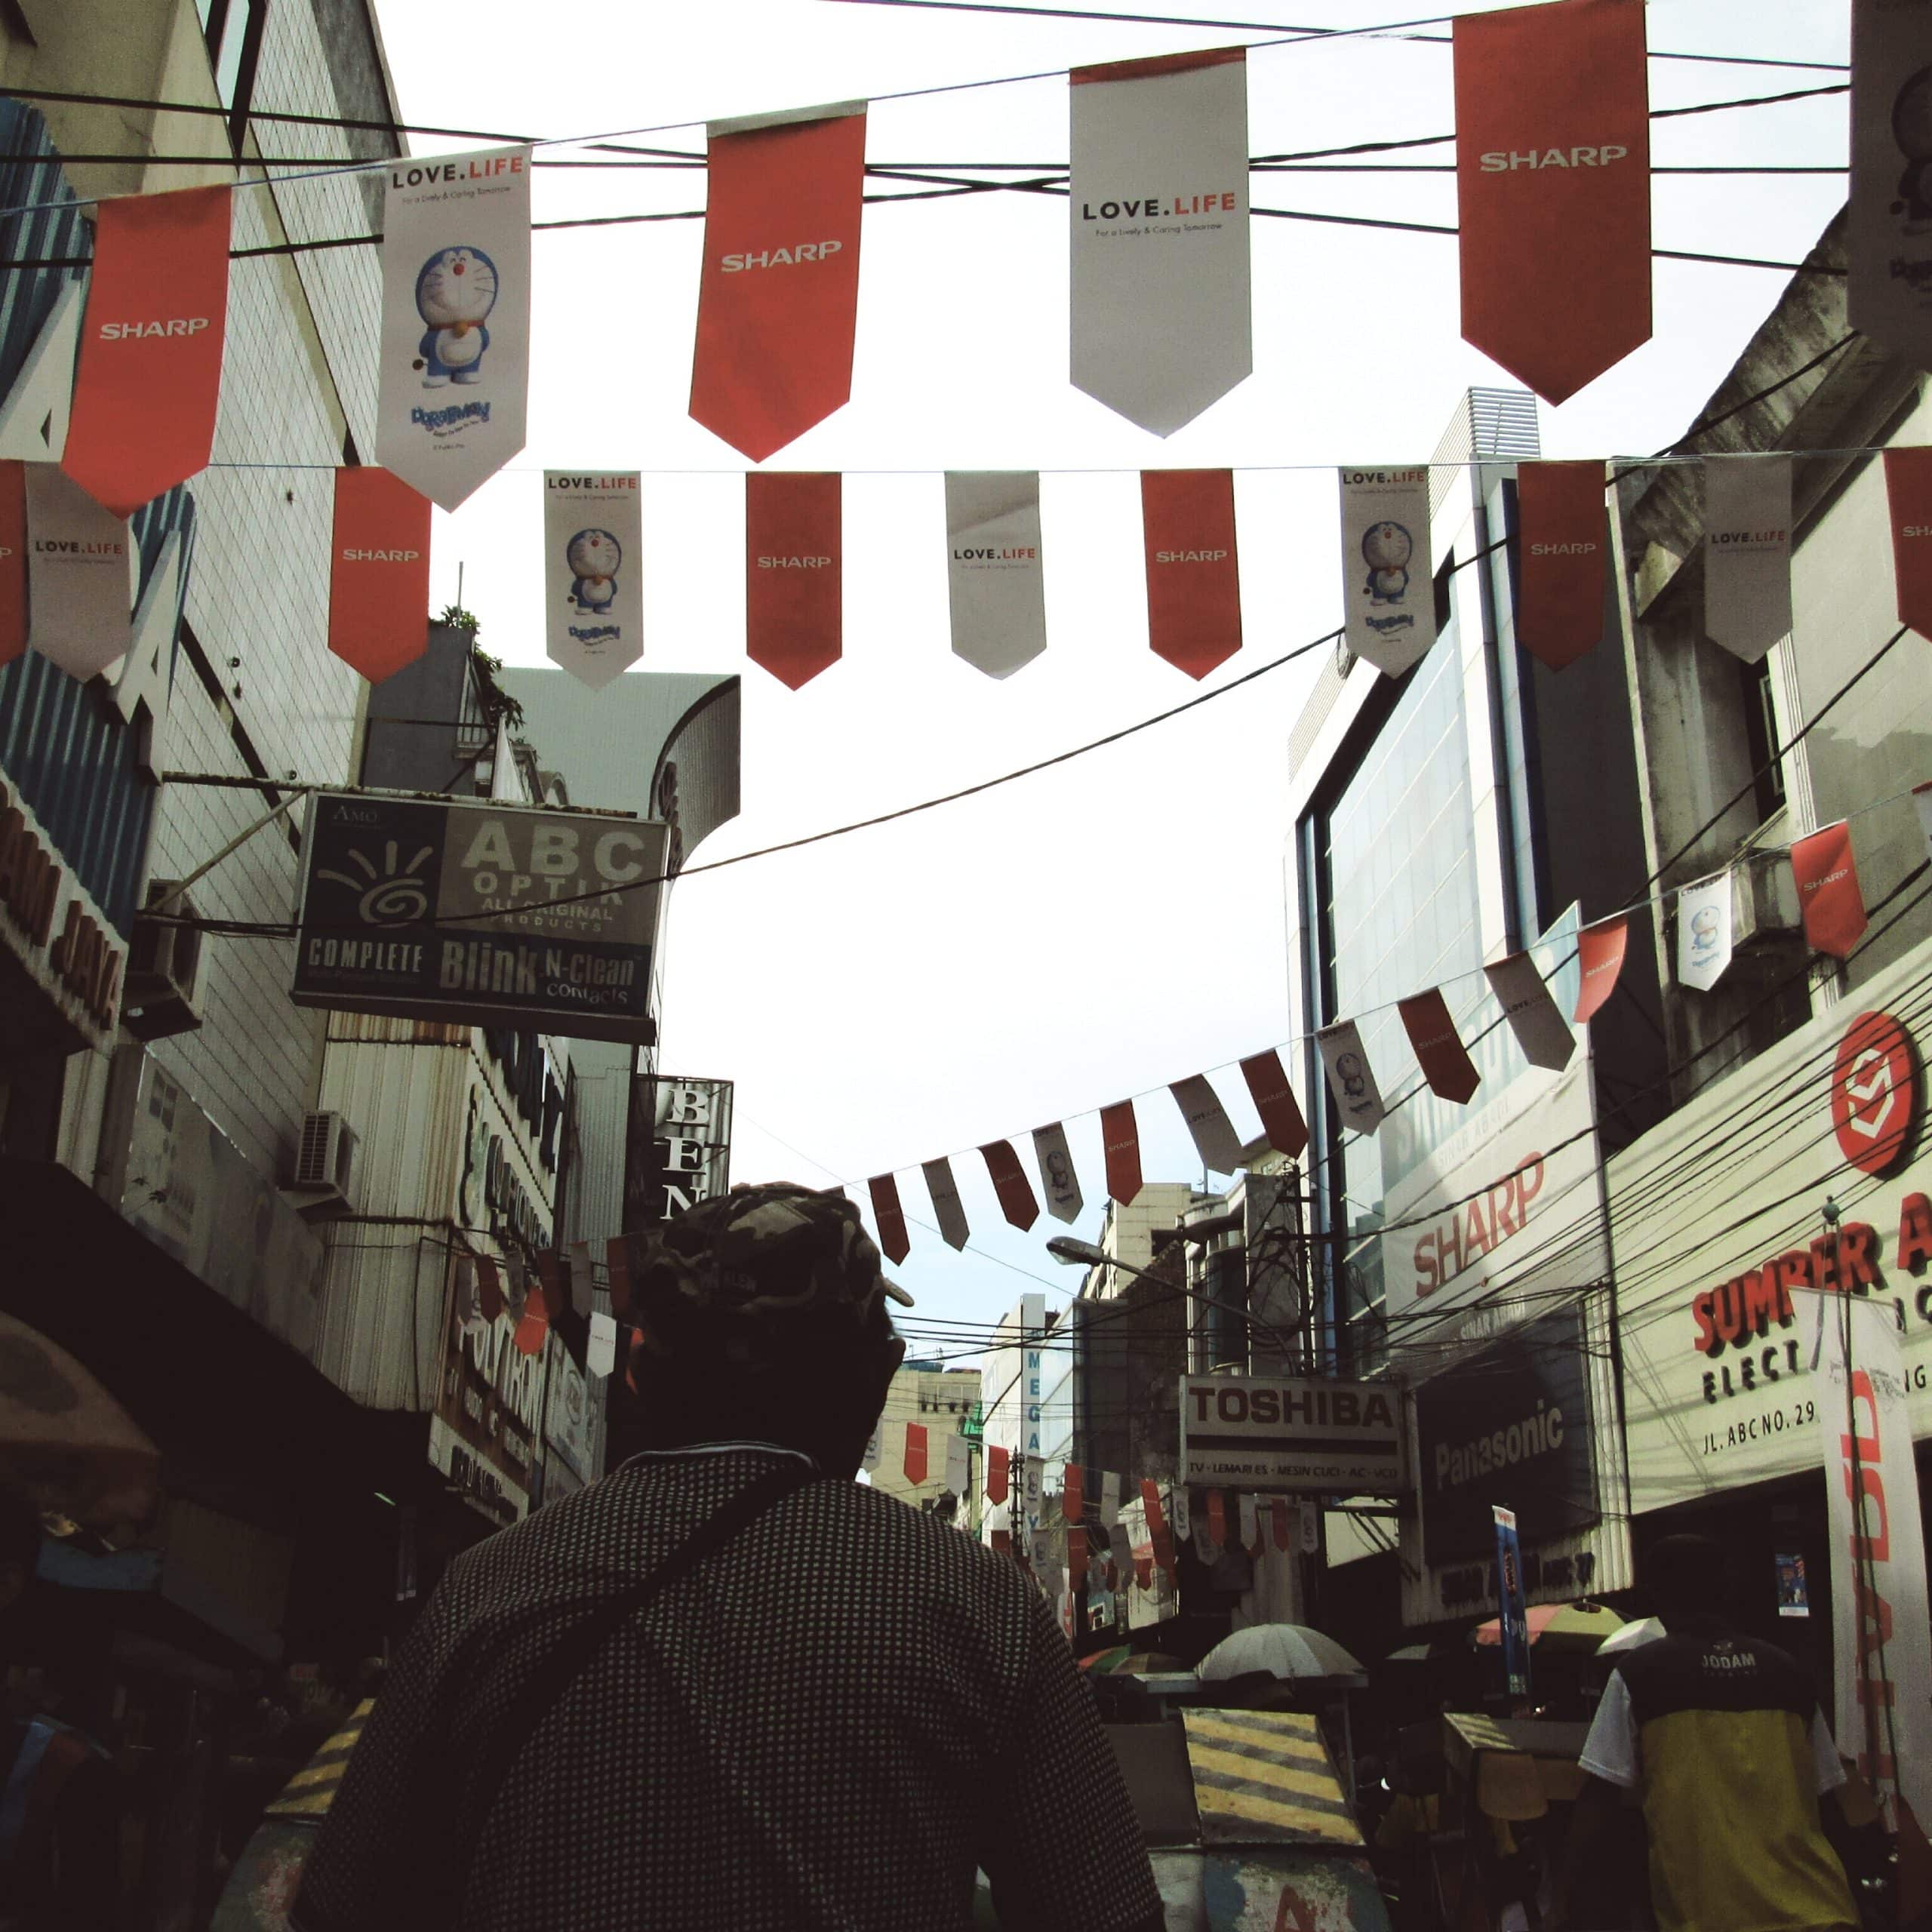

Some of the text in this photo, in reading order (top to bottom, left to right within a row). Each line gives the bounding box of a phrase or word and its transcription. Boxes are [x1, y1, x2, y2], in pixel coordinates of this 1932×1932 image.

[1479, 145, 1628, 173] SHARP
[392, 156, 523, 189] LOVE.LIFE
[1082, 192, 1235, 220] LOVE.LIFE
[1144, 226, 1150, 235] &
[1152, 225, 1180, 234] Caring
[721, 239, 843, 273] SHARP
[99, 317, 211, 340] SHARP
[549, 477, 636, 489] LOVE.LIFE
[1343, 471, 1424, 485] LOVE.LIFE
[1711, 529, 1786, 545] LOVE.LIFE
[1903, 525, 1932, 537] SH
[35, 540, 123, 555] LOVE.LIFE
[342, 548, 419, 561] SHARP
[954, 548, 1036, 560] LOVE.LIFE
[1155, 549, 1228, 563] SHARP
[1531, 542, 1597, 556] SHARP
[757, 555, 832, 569] SHARP
[460, 820, 645, 881] ABC
[473, 871, 623, 906] OPTIK
[1803, 869, 1847, 893] SHARP
[492, 912, 602, 932] RODUCTS
[308, 937, 423, 972] COMPLETE
[1418, 1032, 1451, 1050] SHARP
[1108, 1139, 1135, 1152] SHARP
[1413, 1151, 1544, 1298] SHARP
[1189, 1386, 1394, 1428] TOSHIBA
[1727, 1418, 1758, 1447] ABC
[1761, 1409, 1790, 1435] NO.
[1435, 1398, 1564, 1491] Panasonic
[1189, 1462, 1204, 1473] TV
[1254, 1465, 1268, 1475] ES
[1277, 1466, 1310, 1477] MESIN
[1312, 1466, 1340, 1478] CUCI
[1349, 1466, 1367, 1478] AC
